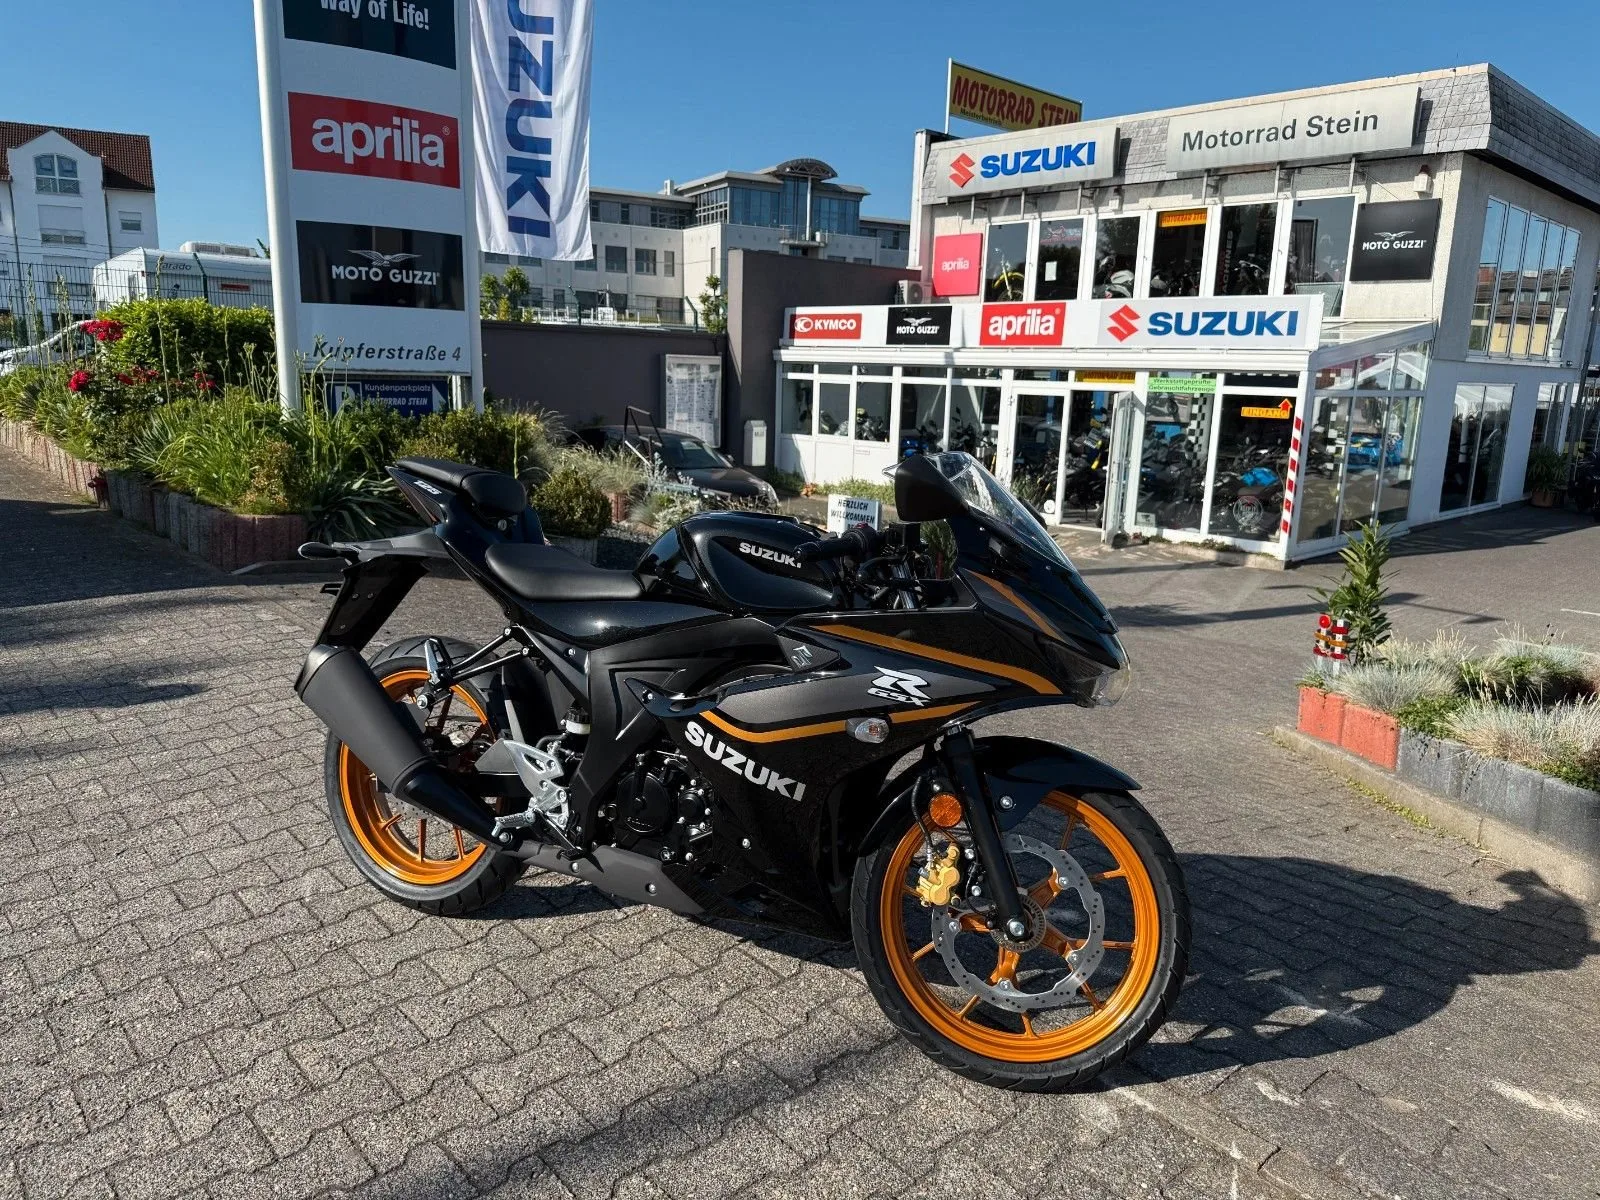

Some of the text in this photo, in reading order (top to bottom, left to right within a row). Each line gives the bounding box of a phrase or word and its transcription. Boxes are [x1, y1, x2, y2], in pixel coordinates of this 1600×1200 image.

[368, 0, 387, 19] of
[393, 0, 429, 30] Life!
[953, 75, 1035, 125] MOTORRAD
[1182, 110, 1378, 152] Motorrad Stein
[311, 116, 445, 168] aprilia
[980, 140, 1096, 179] SUZUKI
[1362, 239, 1424, 251] MOTO GUZZI
[332, 264, 437, 286] MOTO GUZZI
[941, 257, 970, 272] aprilia
[814, 318, 857, 331] KYMCO
[896, 325, 938, 334] MOTO GUZZI
[988, 308, 1055, 341] aprilia
[1147, 310, 1299, 337] SUZUKI
[313, 341, 462, 362] Kupferstraße 4
[364, 383, 431, 393] Kundenparkplatz
[408, 397, 428, 406] STEIN
[837, 499, 869, 511] HERZLICH
[830, 510, 875, 524] WILLKOMMEN
[684, 721, 807, 802] SUZUKI
